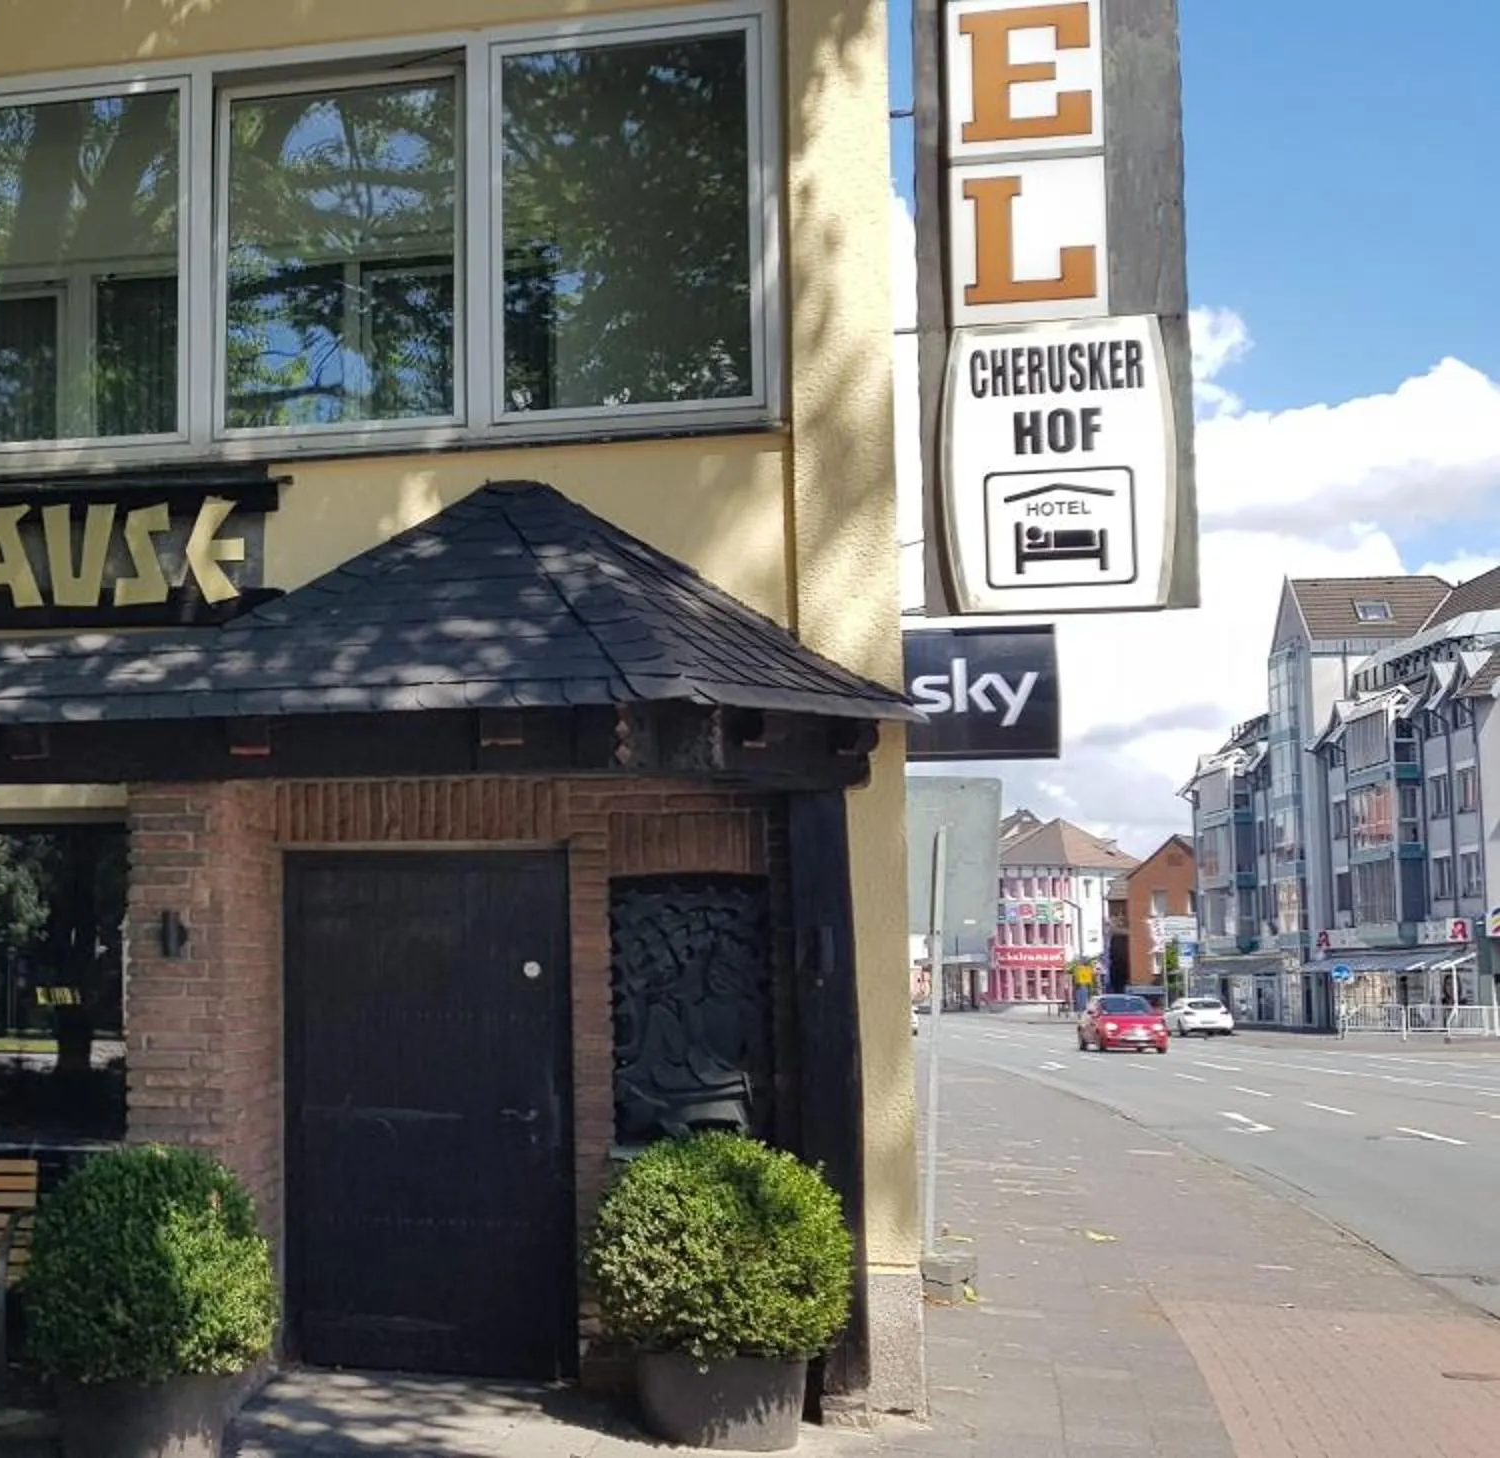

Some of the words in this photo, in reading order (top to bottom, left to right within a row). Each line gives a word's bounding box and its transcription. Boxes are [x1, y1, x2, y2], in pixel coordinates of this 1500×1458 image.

[969, 339, 1145, 399] CHERUSKER
[1013, 407, 1102, 455] HOF
[1026, 500, 1092, 516] HOTEL
[911, 657, 1040, 727] sky
